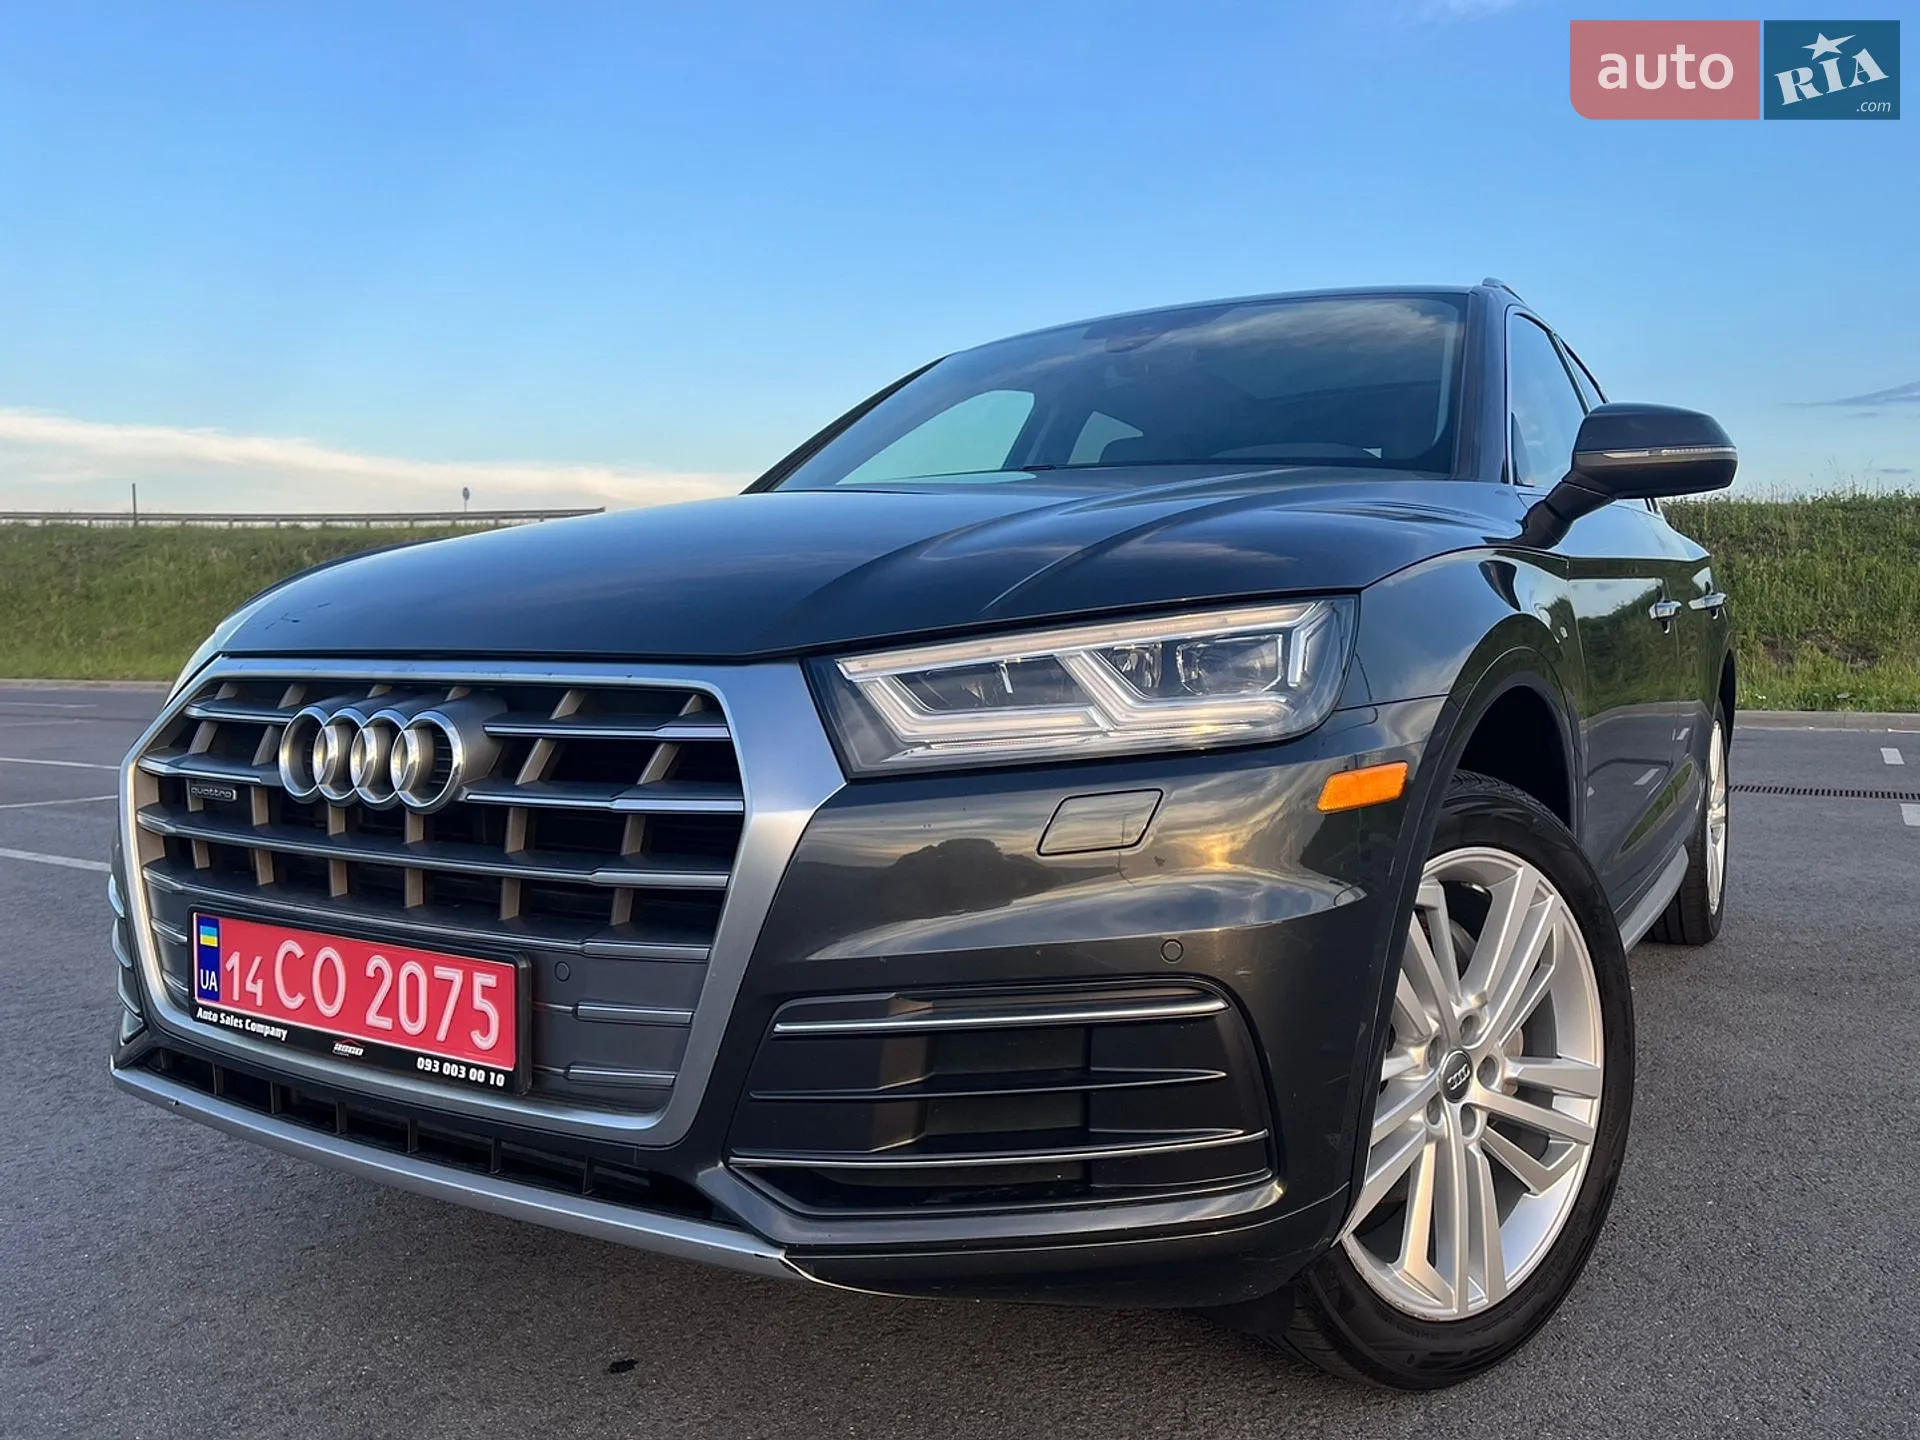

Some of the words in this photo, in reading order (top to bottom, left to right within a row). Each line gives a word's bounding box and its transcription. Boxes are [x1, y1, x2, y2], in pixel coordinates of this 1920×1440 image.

[200, 969, 218, 992] UA
[365, 954, 500, 1051] 2075
[196, 1007, 219, 1022] Auto
[220, 1012, 243, 1029] Sales
[245, 1019, 288, 1041] Company
[417, 1056, 440, 1073] 093
[442, 1062, 466, 1078] 003
[469, 1068, 486, 1083] 00
[489, 1072, 505, 1087] 10
